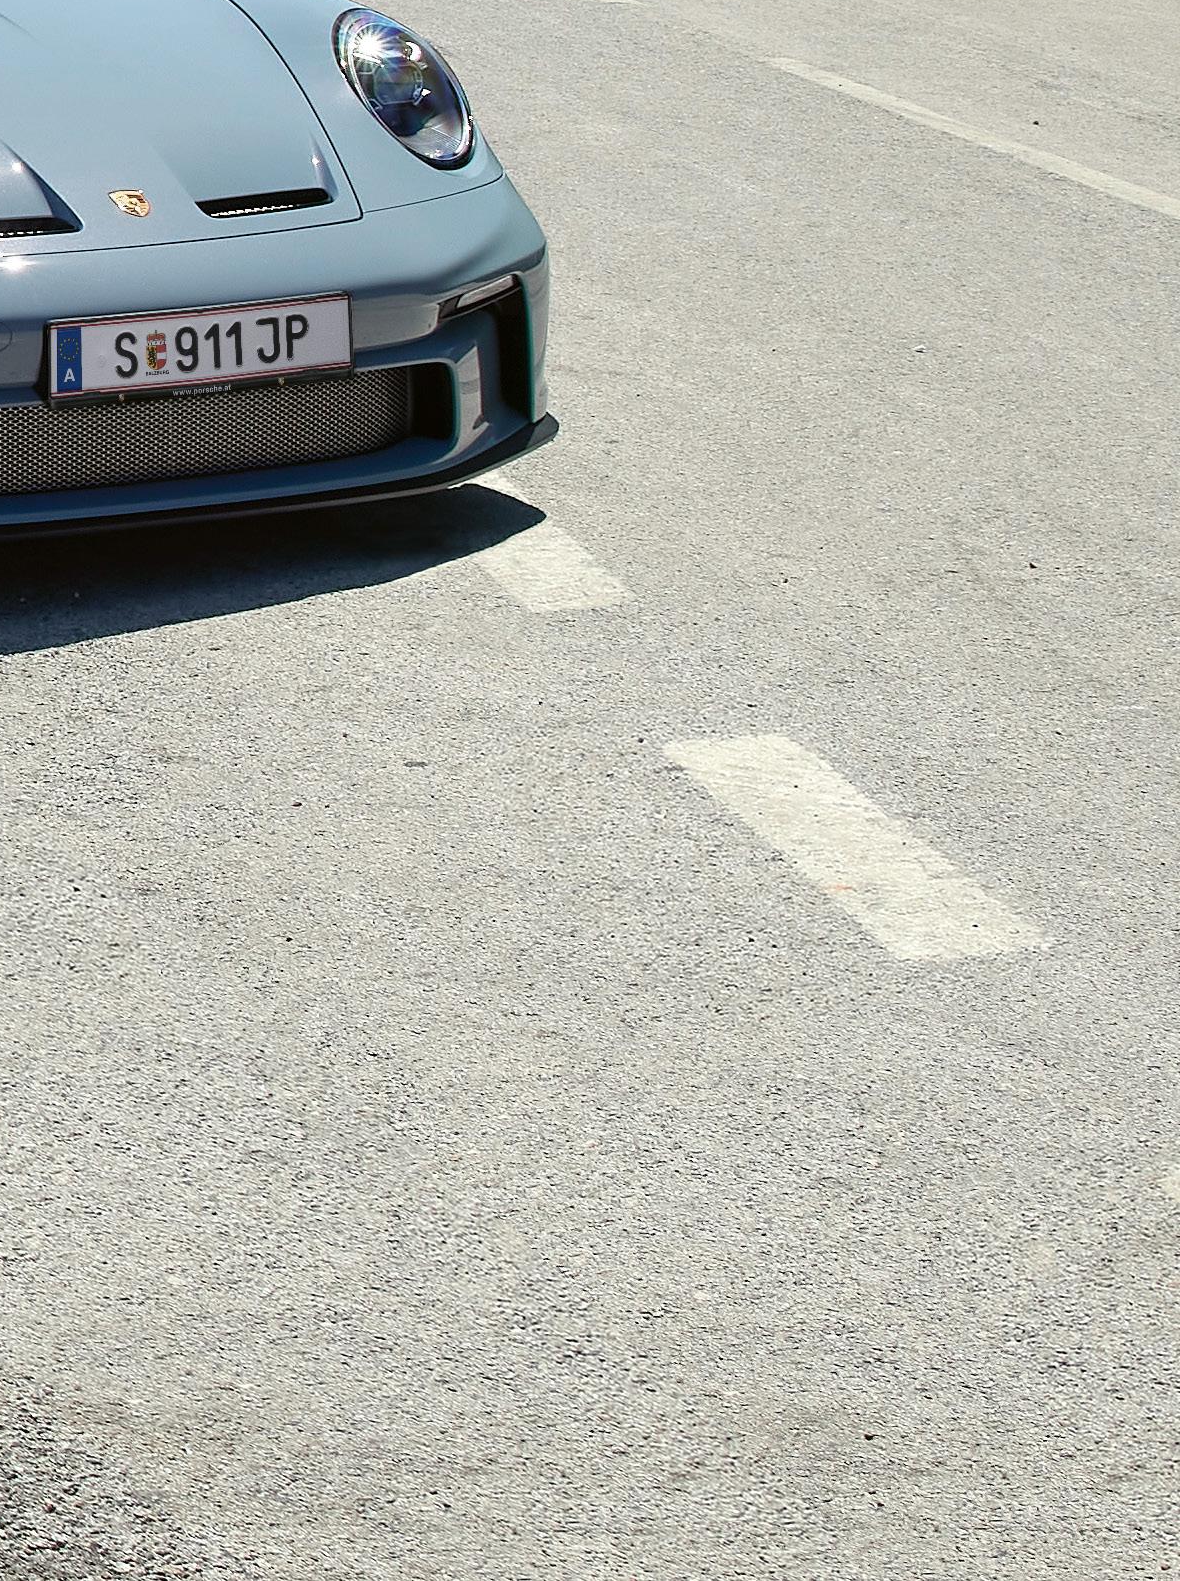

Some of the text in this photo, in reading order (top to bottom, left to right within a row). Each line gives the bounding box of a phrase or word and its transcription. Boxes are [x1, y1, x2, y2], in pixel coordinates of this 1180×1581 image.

[115, 314, 309, 378] S 911 JP
[63, 368, 76, 383] A
[172, 384, 231, 397] www.porsche.at
